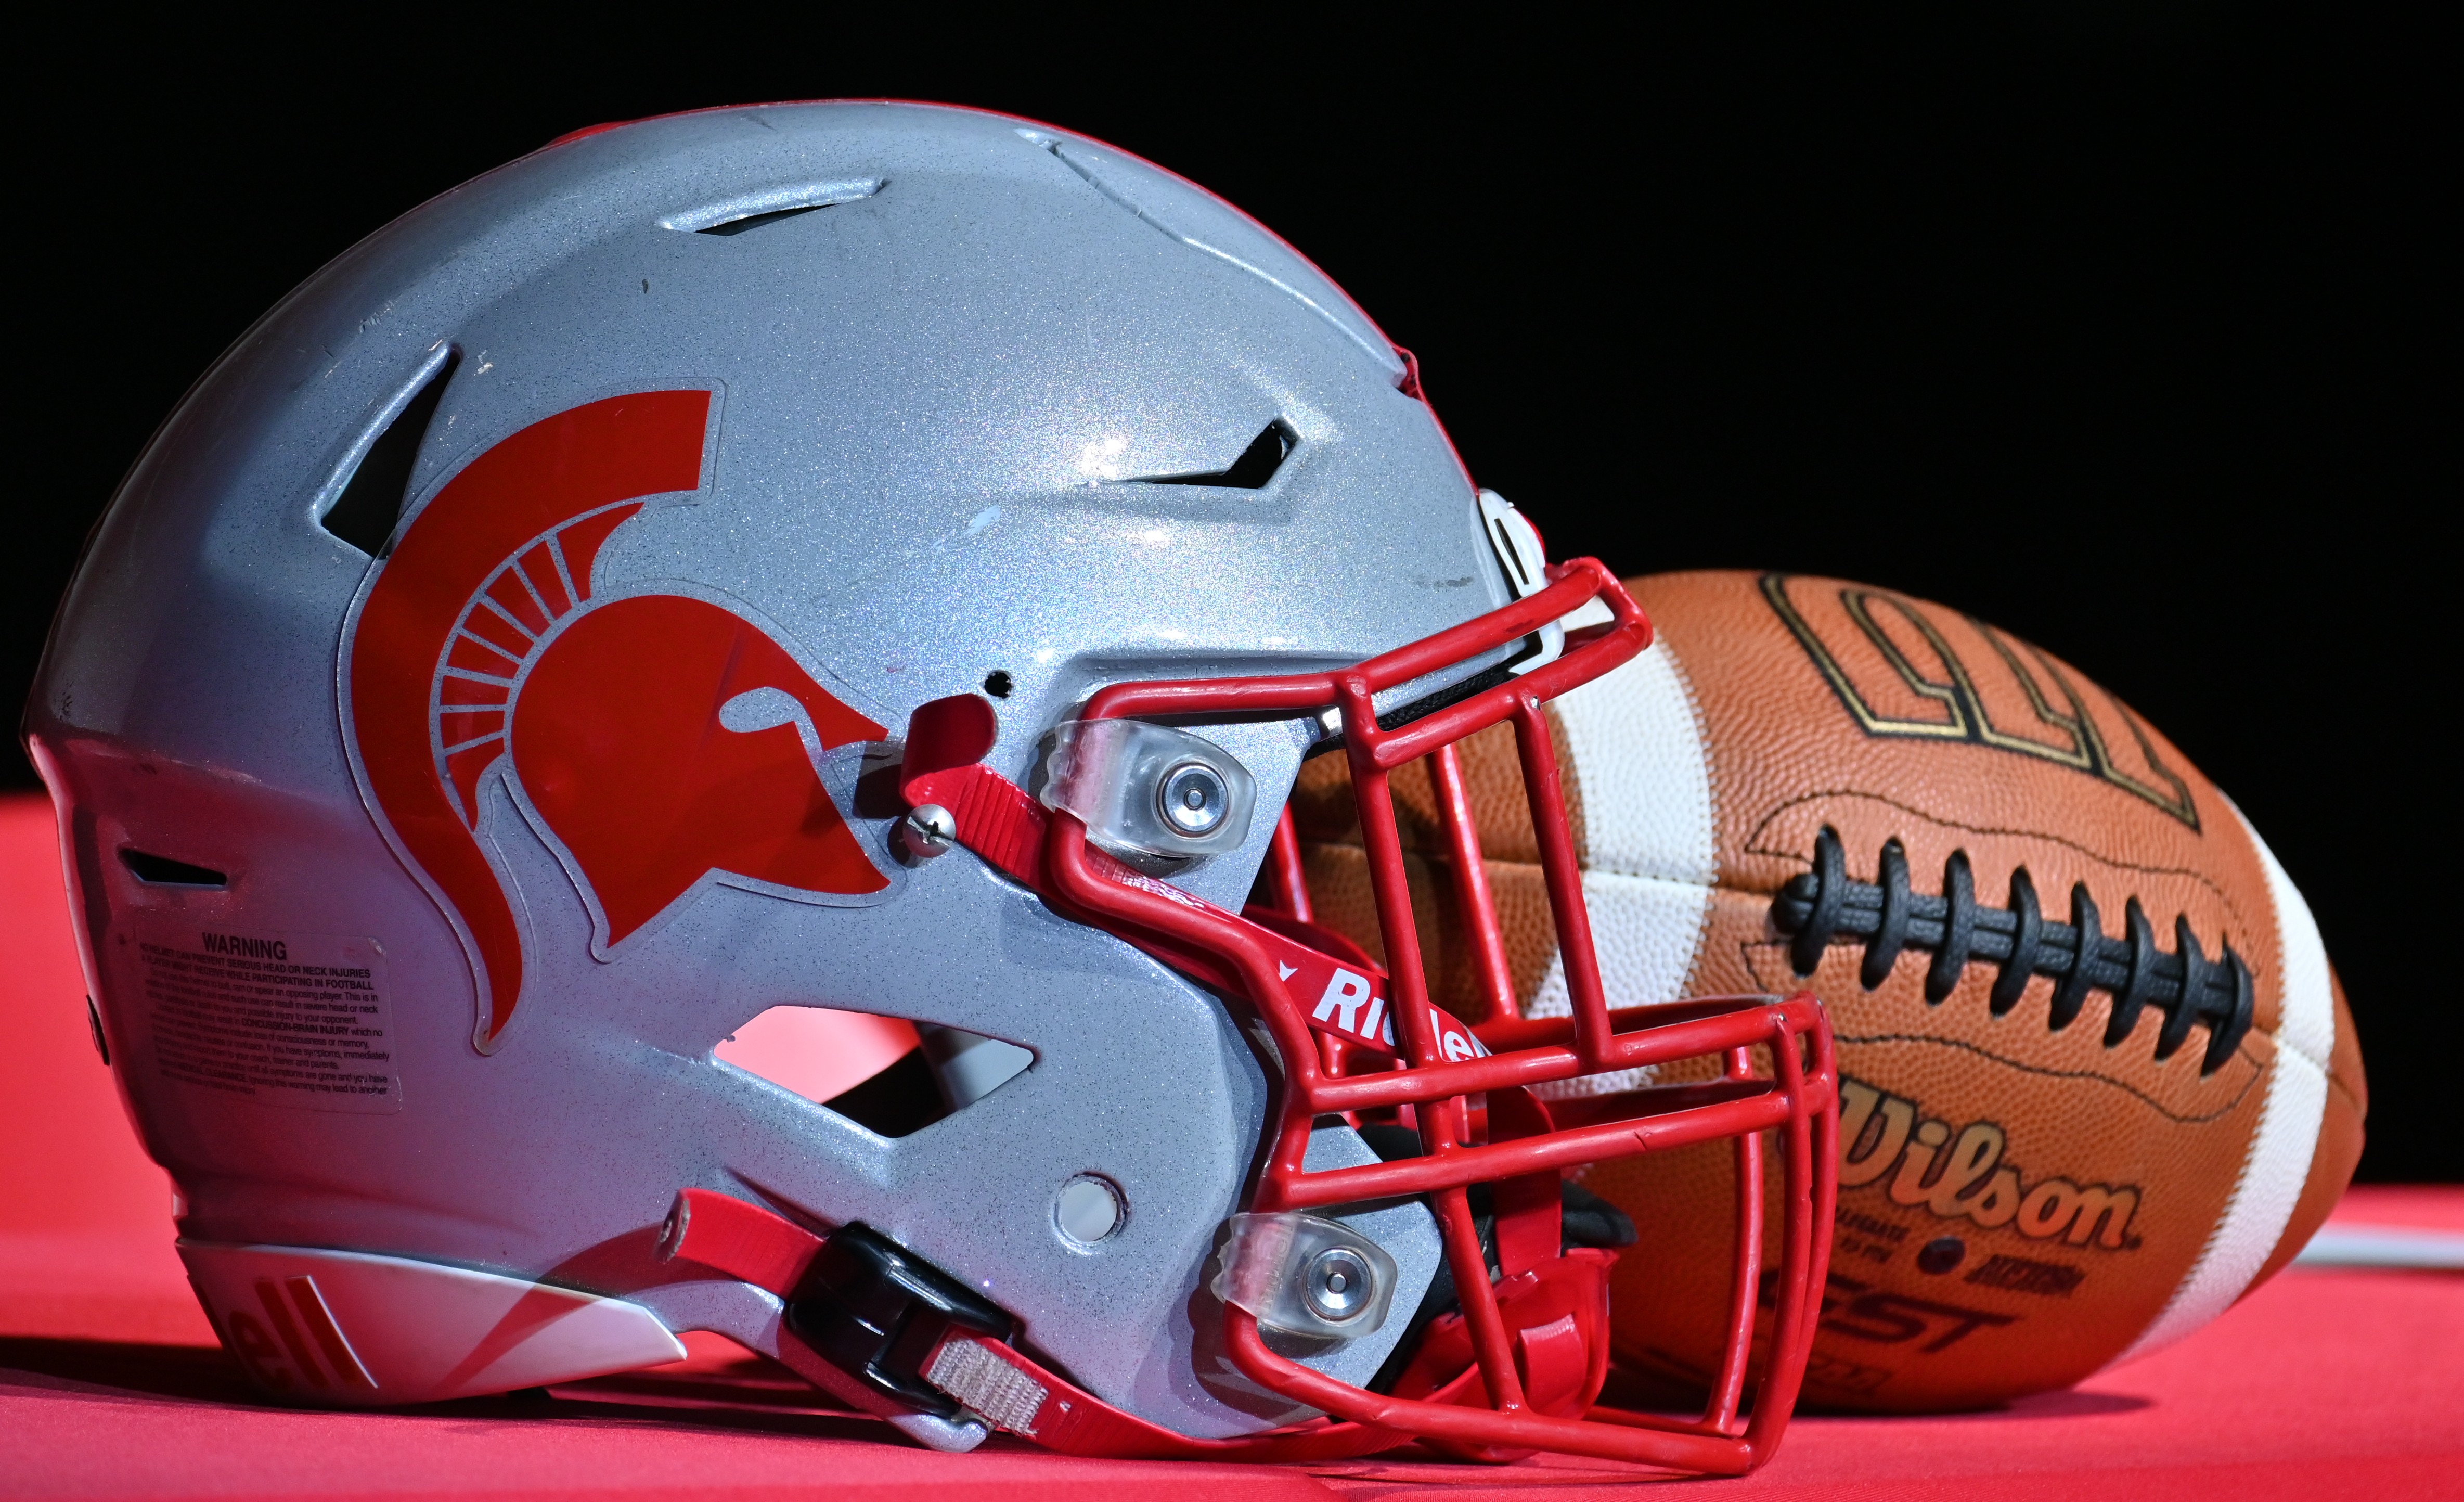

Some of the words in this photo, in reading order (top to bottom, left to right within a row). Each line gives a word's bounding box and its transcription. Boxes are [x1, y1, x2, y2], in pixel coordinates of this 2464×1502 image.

[202, 932, 287, 960] WARNING
[176, 951, 190, 960] CAN
[192, 954, 225, 966] PREVENT
[227, 958, 261, 970] SERIOUS
[263, 963, 286, 973] HEAD
[288, 965, 300, 974] OR
[303, 966, 327, 975] NECK
[329, 968, 370, 978] INJURIES
[226, 970, 250, 981] WHILE
[252, 973, 312, 986] PARTICIPATING
[315, 979, 322, 987] IN
[326, 979, 373, 989] FOOTBALL
[286, 989, 317, 1000] opposing
[275, 999, 293, 1008] result
[304, 1016, 319, 1024] your
[241, 1019, 317, 1033] CONCUSSION-BRAIN
[319, 1026, 349, 1034] INJURY
[276, 1034, 326, 1044] consciousness
[343, 1050, 389, 1062] immediately
[318, 1072, 336, 1082] gone
[353, 1075, 367, 1084] you
[316, 1084, 330, 1092] may
